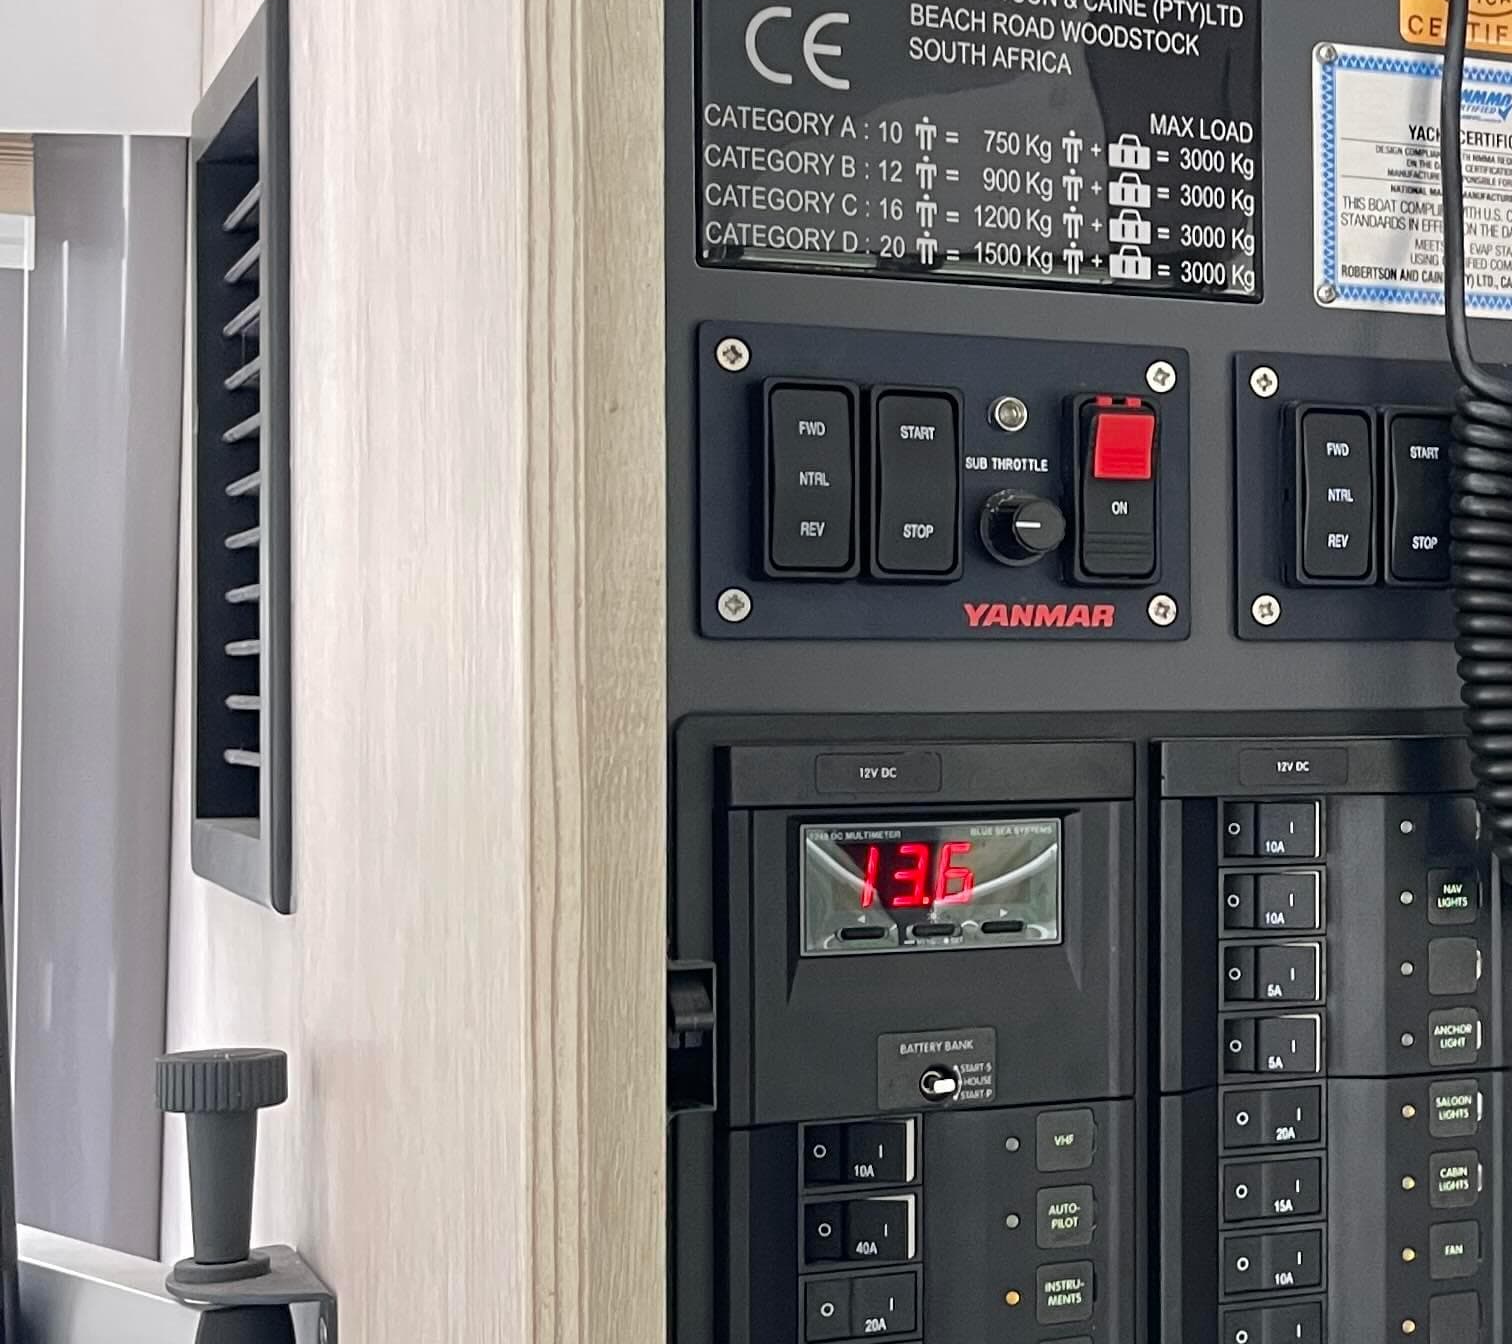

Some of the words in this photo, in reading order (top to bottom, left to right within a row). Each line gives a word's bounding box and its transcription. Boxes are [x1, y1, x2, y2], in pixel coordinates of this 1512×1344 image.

[910, 3, 985, 32] BEACH
[993, 14, 1053, 39] ROAD
[1060, 21, 1199, 56] WOODSTOCK
[745, 6, 849, 90] CE
[909, 38, 984, 66] SOUTH
[992, 48, 1071, 75] AFRICA
[1150, 114, 1194, 137] MAX
[1200, 120, 1253, 143] LOAD
[704, 104, 834, 138] CATEGORY
[841, 119, 856, 138] A
[879, 122, 902, 143] 10
[984, 130, 1019, 155] 750
[1025, 134, 1051, 162] Kg
[1180, 149, 1225, 173] 3000
[1231, 153, 1253, 180] Kg
[704, 144, 834, 177] CATEGORY
[841, 158, 855, 176] B
[879, 161, 902, 182] 12
[983, 169, 1019, 193] 900
[1025, 173, 1052, 201] Kg
[1180, 186, 1225, 209] 3000
[1231, 190, 1254, 216] Kg
[705, 183, 835, 216] CATEGORY
[842, 196, 858, 216] C
[879, 199, 903, 220] 16
[974, 206, 1020, 231] 1200
[1026, 210, 1052, 238] Kg
[1181, 225, 1226, 248] 3000
[1231, 230, 1255, 255] Kg
[705, 222, 836, 254] CATEGORY
[843, 233, 859, 253] D
[881, 236, 905, 257] 20
[974, 242, 1021, 266] 1500
[1026, 246, 1053, 273] Kg
[1181, 263, 1226, 286] 3000
[1232, 268, 1255, 292] Kg
[800, 422, 825, 437] FWD
[900, 426, 935, 441] START
[1327, 443, 1349, 457] FWD
[1410, 447, 1439, 460] START
[965, 457, 987, 470] SUB
[992, 457, 1048, 473] THROTTLE
[800, 472, 829, 487] NTRL
[1328, 488, 1353, 502] NTRL
[1112, 501, 1128, 515] ON
[801, 522, 824, 537] REV
[903, 524, 933, 539] STOP
[1328, 534, 1348, 548] REV
[1412, 536, 1437, 550] STOP
[964, 604, 1115, 628] YANMAR
[860, 768, 878, 779] 12V
[881, 767, 897, 778] DC
[861, 842, 975, 908] 13.6
[900, 1041, 942, 1055] BATTERY
[945, 1040, 974, 1051] BANK
[854, 1165, 874, 1178] 10A
[1049, 1203, 1080, 1216] AUTO-
[1051, 1216, 1078, 1229] PILOT
[856, 1242, 877, 1255] 40A
[1445, 1244, 1463, 1255] FAN
